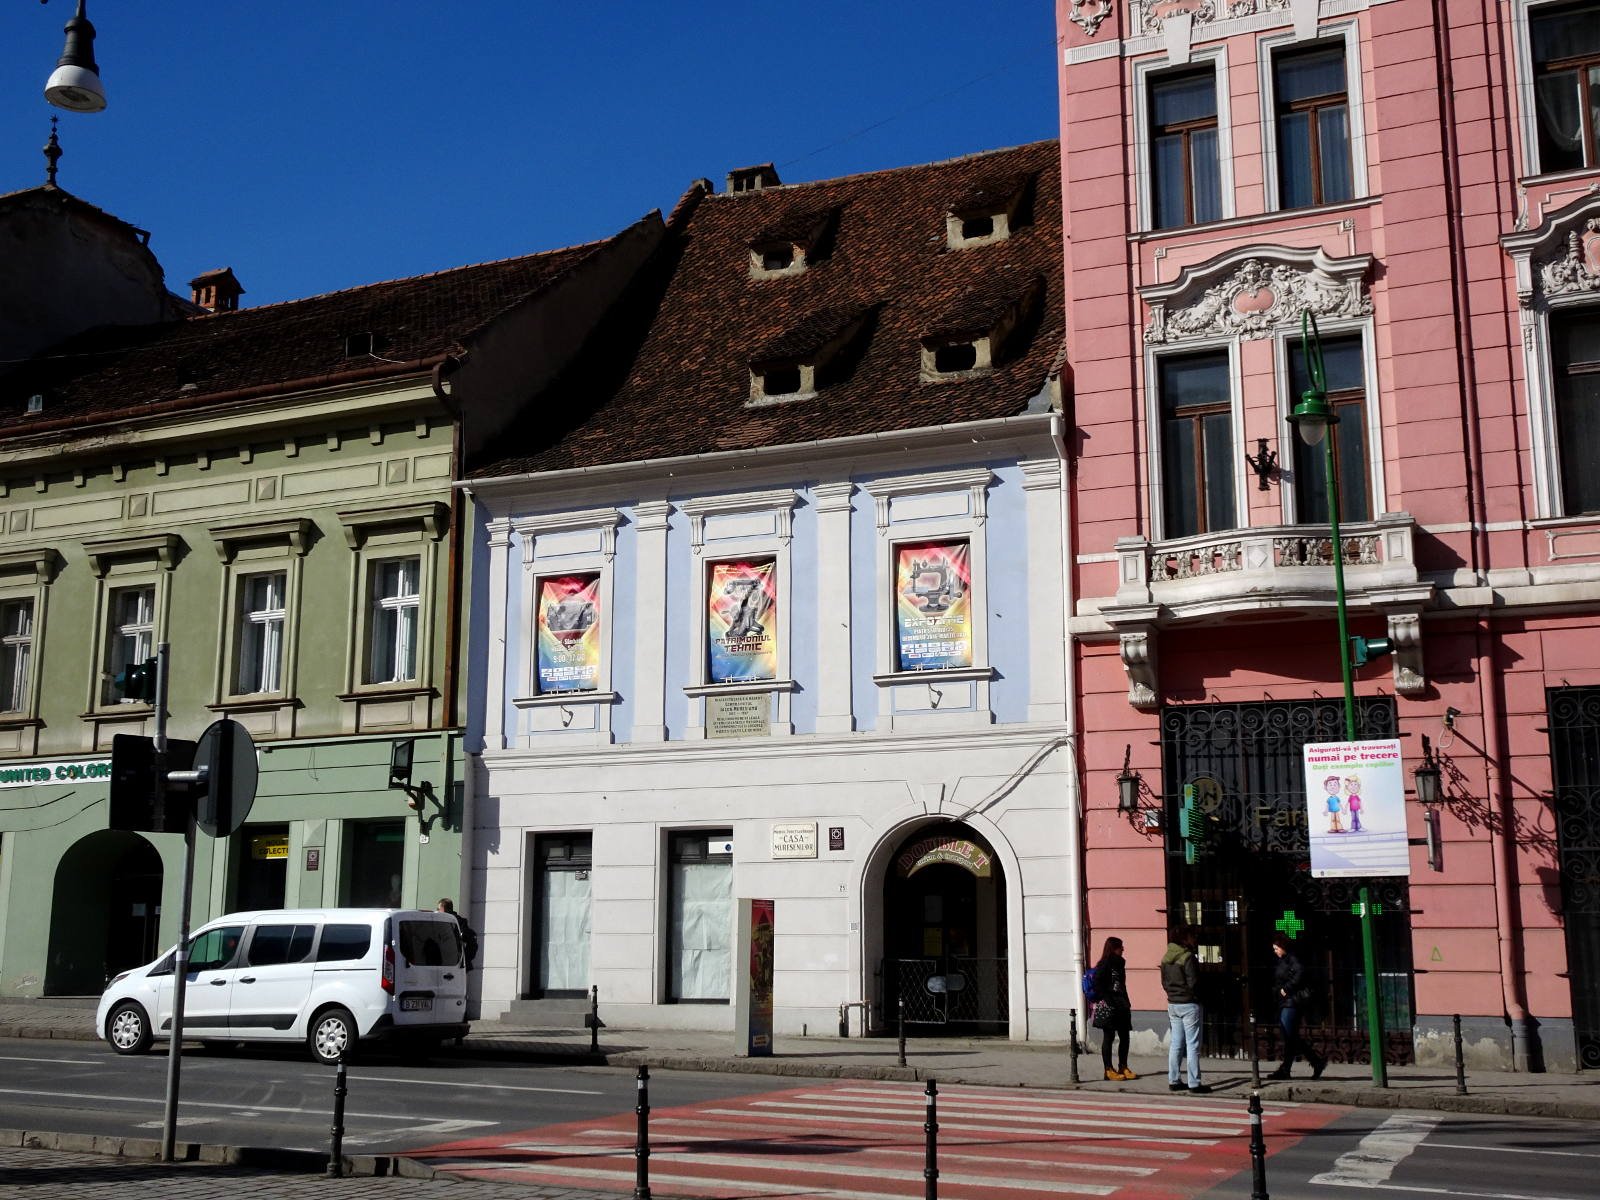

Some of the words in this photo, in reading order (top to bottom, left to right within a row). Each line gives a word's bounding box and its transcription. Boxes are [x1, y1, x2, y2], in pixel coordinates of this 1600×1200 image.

[715, 634, 771, 645] PATRIMONIUL
[725, 643, 762, 652] TEHNIC
[1308, 754, 1340, 762] numai
[1343, 754, 1357, 762] pe
[1360, 752, 1399, 760] trecere
[1255, 806, 1308, 828] Far
[783, 834, 804, 843] CASA
[899, 837, 974, 870] DOUBLE
[974, 852, 990, 869] T
